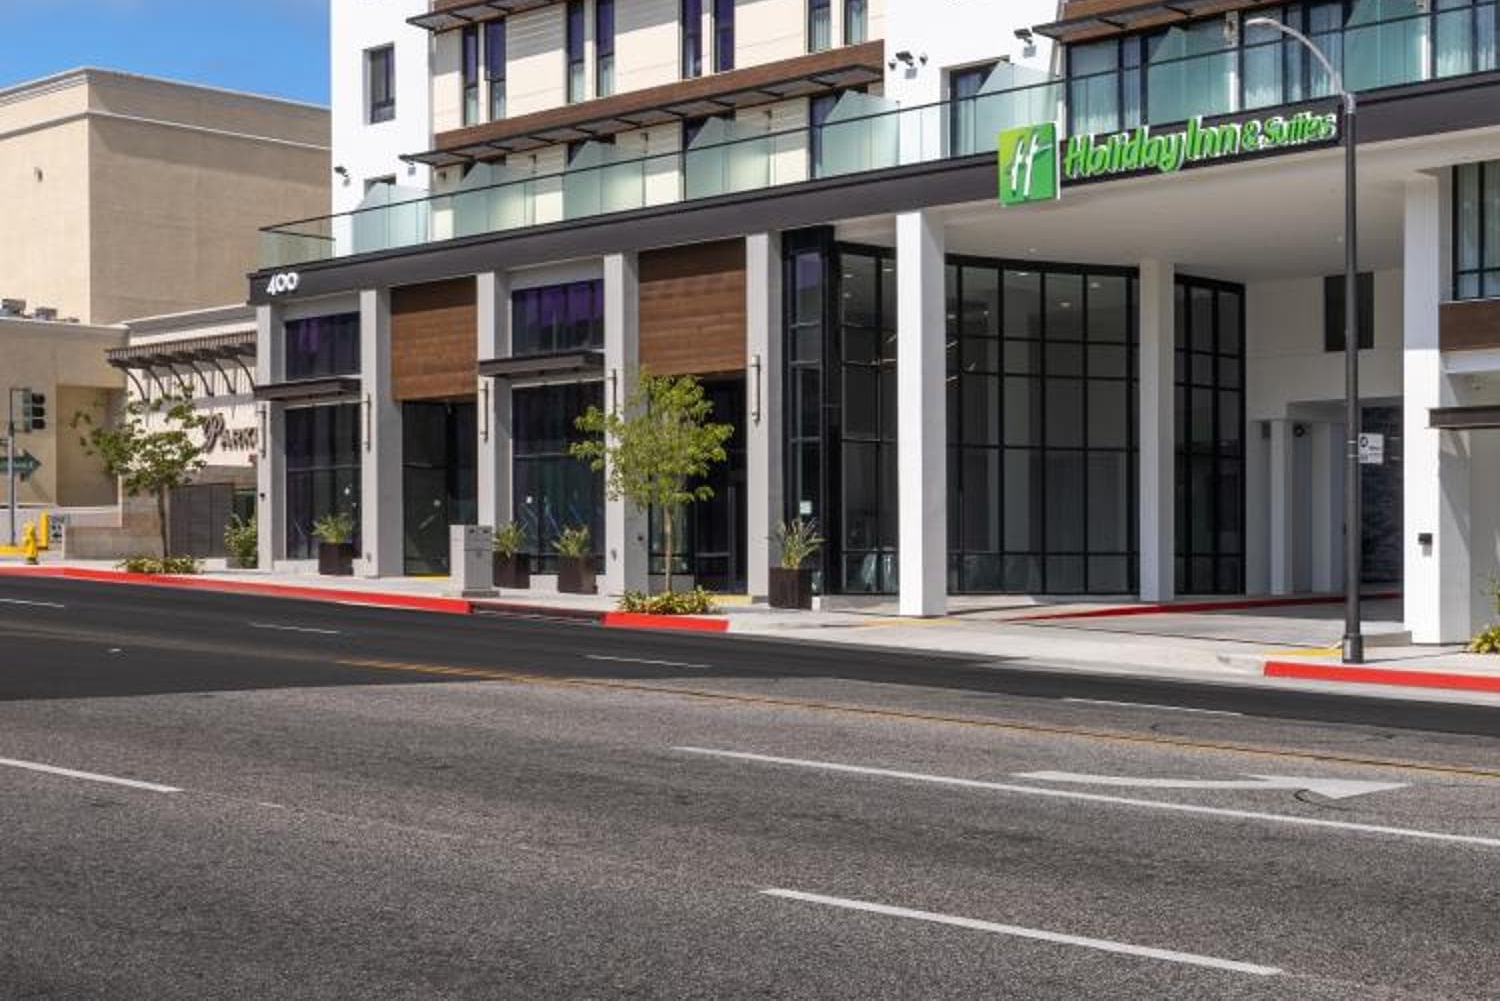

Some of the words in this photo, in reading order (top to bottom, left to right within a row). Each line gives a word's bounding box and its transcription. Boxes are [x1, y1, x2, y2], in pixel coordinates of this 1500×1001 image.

[1064, 125, 1186, 178] Holiday
[1186, 115, 1241, 160] Inn
[1242, 118, 1265, 151] &
[1264, 111, 1337, 147] Suites
[266, 272, 299, 296] 400
